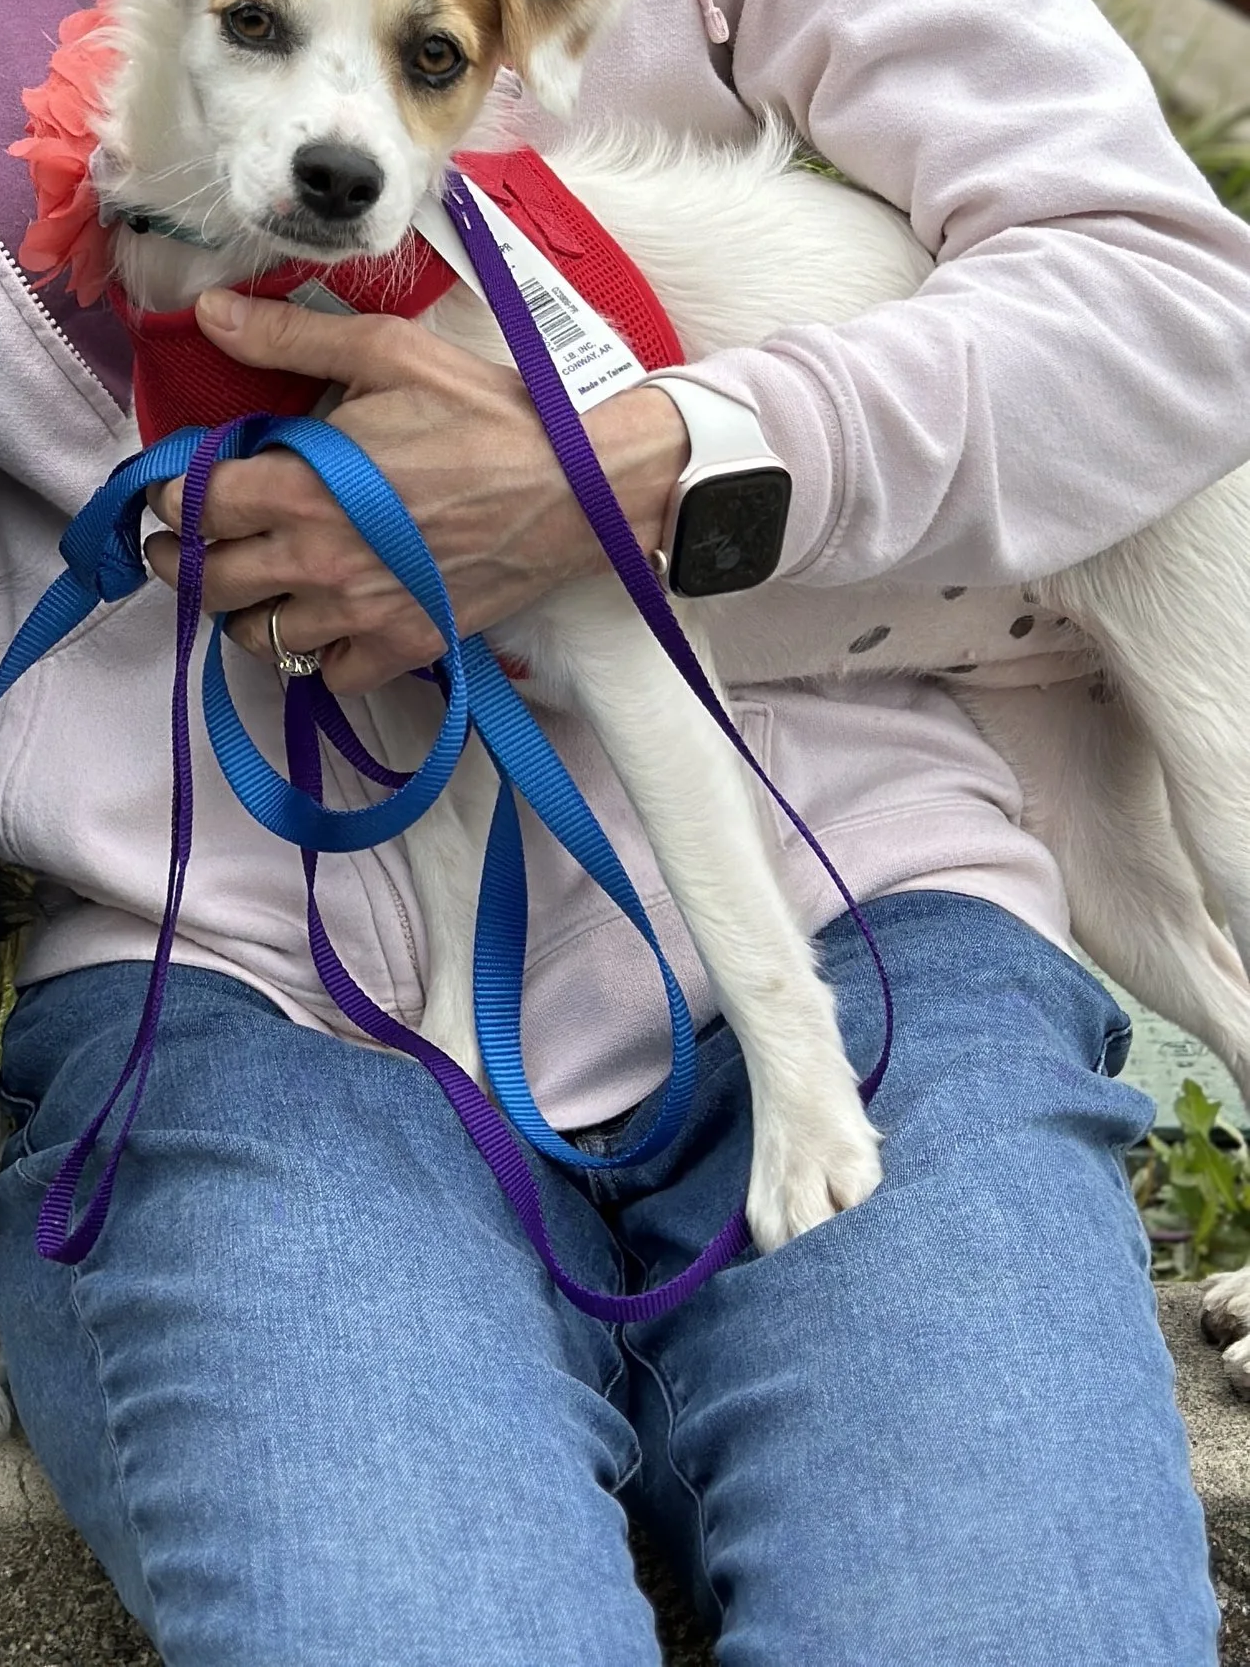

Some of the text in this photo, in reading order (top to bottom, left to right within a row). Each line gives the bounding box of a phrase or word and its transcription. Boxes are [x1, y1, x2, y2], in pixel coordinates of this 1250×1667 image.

[561, 343, 613, 375] CONWAY, AR
[577, 362, 633, 395] Made in Taiwan
